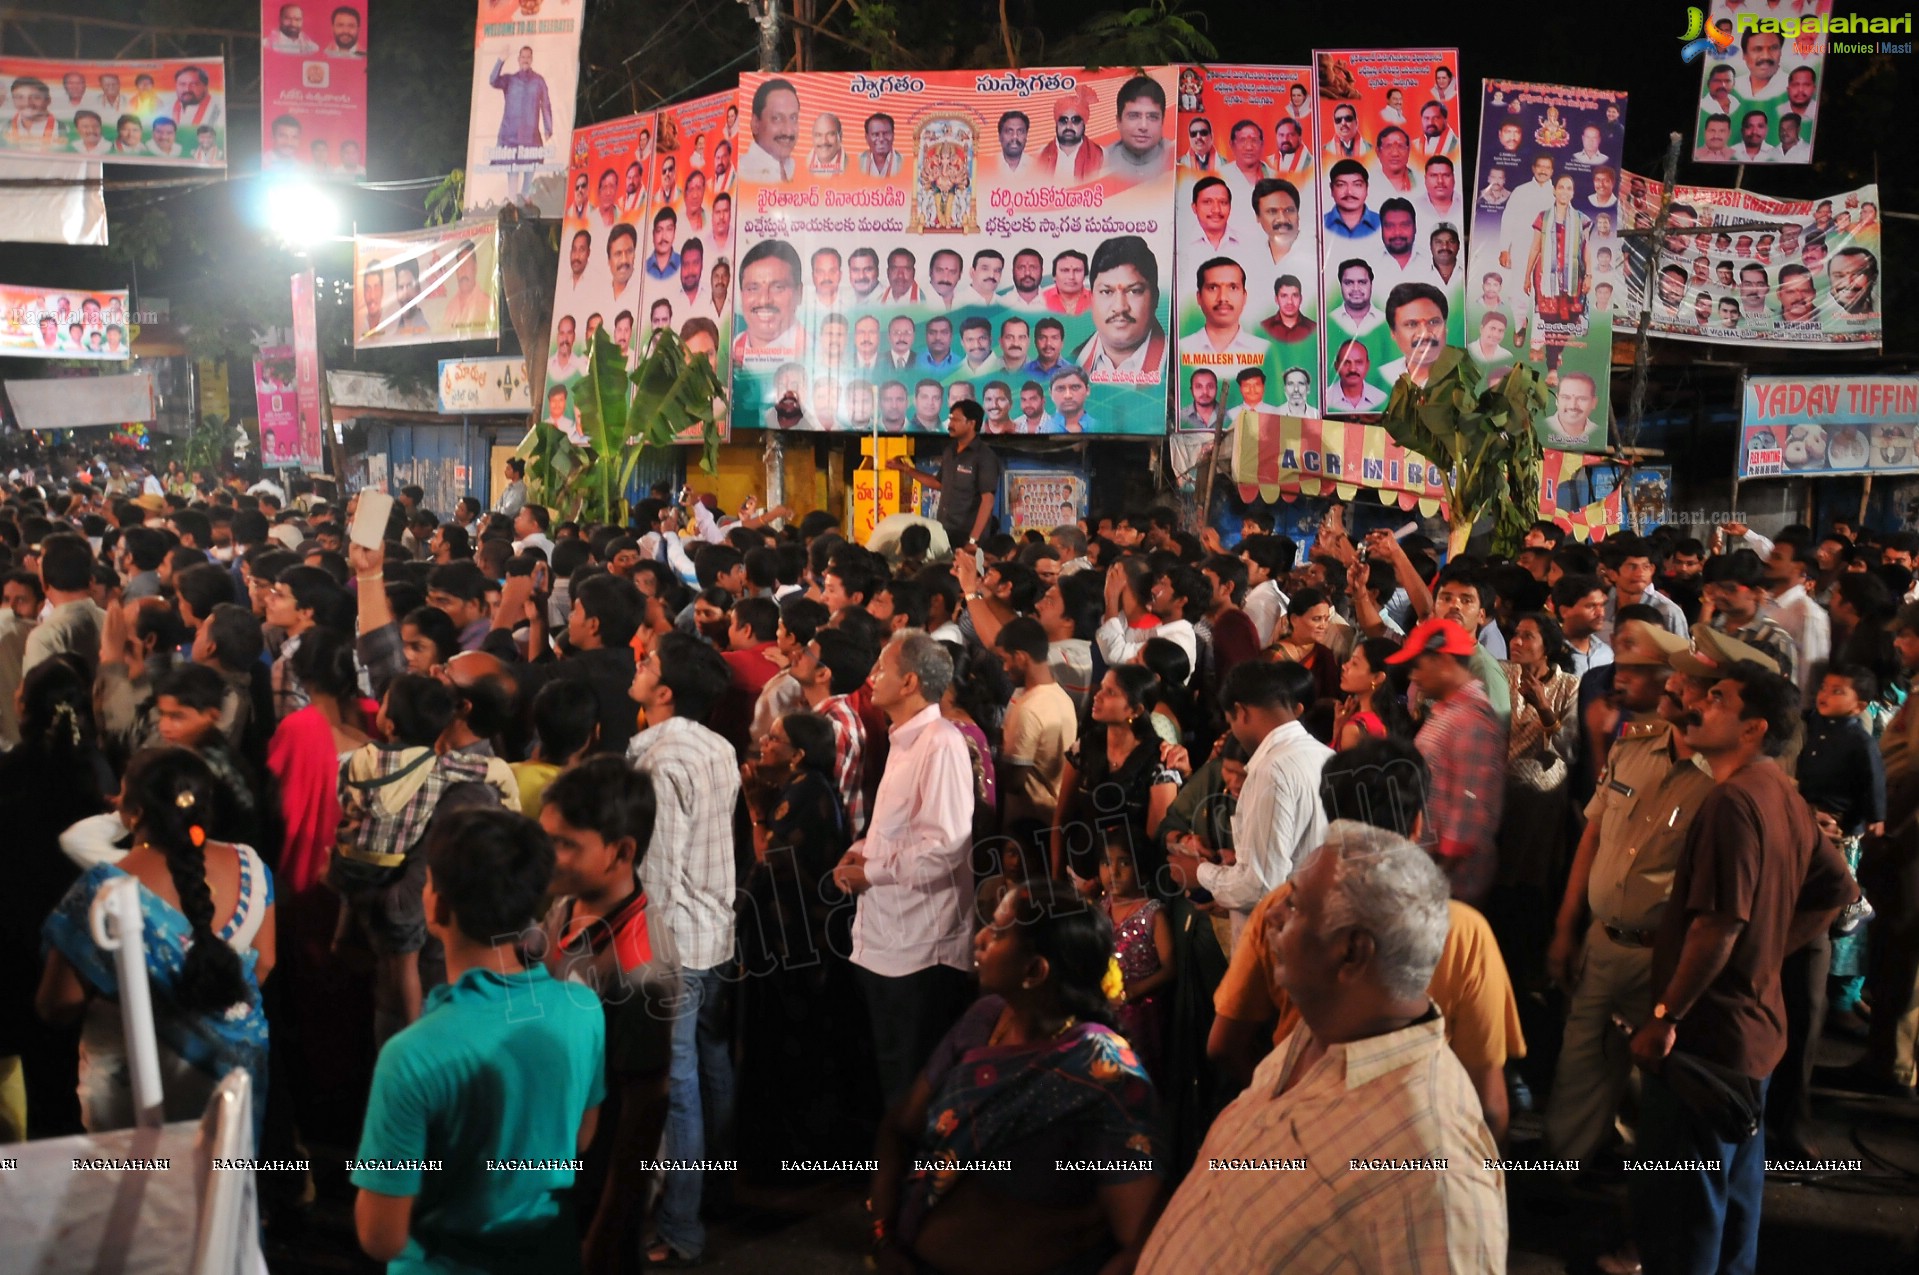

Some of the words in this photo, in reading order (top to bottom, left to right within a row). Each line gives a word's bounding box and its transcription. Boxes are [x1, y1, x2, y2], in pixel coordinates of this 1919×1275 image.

[484, 22, 515, 37] WELCOME
[517, 21, 525, 35] TO
[526, 20, 536, 34] ALL
[851, 75, 924, 99] స్వాగతం
[976, 72, 1075, 97] సుస్వాగతం
[758, 187, 819, 213] ఖైరతాబాద్
[825, 186, 905, 207] వినాయకుడిని
[990, 185, 1104, 215] దర్శించుకోవడానికి
[791, 217, 855, 233] నాయకులకు
[858, 217, 903, 233] మరియు
[985, 216, 1036, 238] భక్తులకు
[1039, 215, 1082, 238] స్వాగత
[1085, 216, 1158, 233] సుమాంజలి
[1182, 353, 1233, 365] M.MALLESH
[1236, 353, 1264, 365] YADAV
[1753, 383, 1840, 420] YADAV
[1847, 383, 1918, 417] TIFFIN
[1281, 448, 1341, 475] ACR
